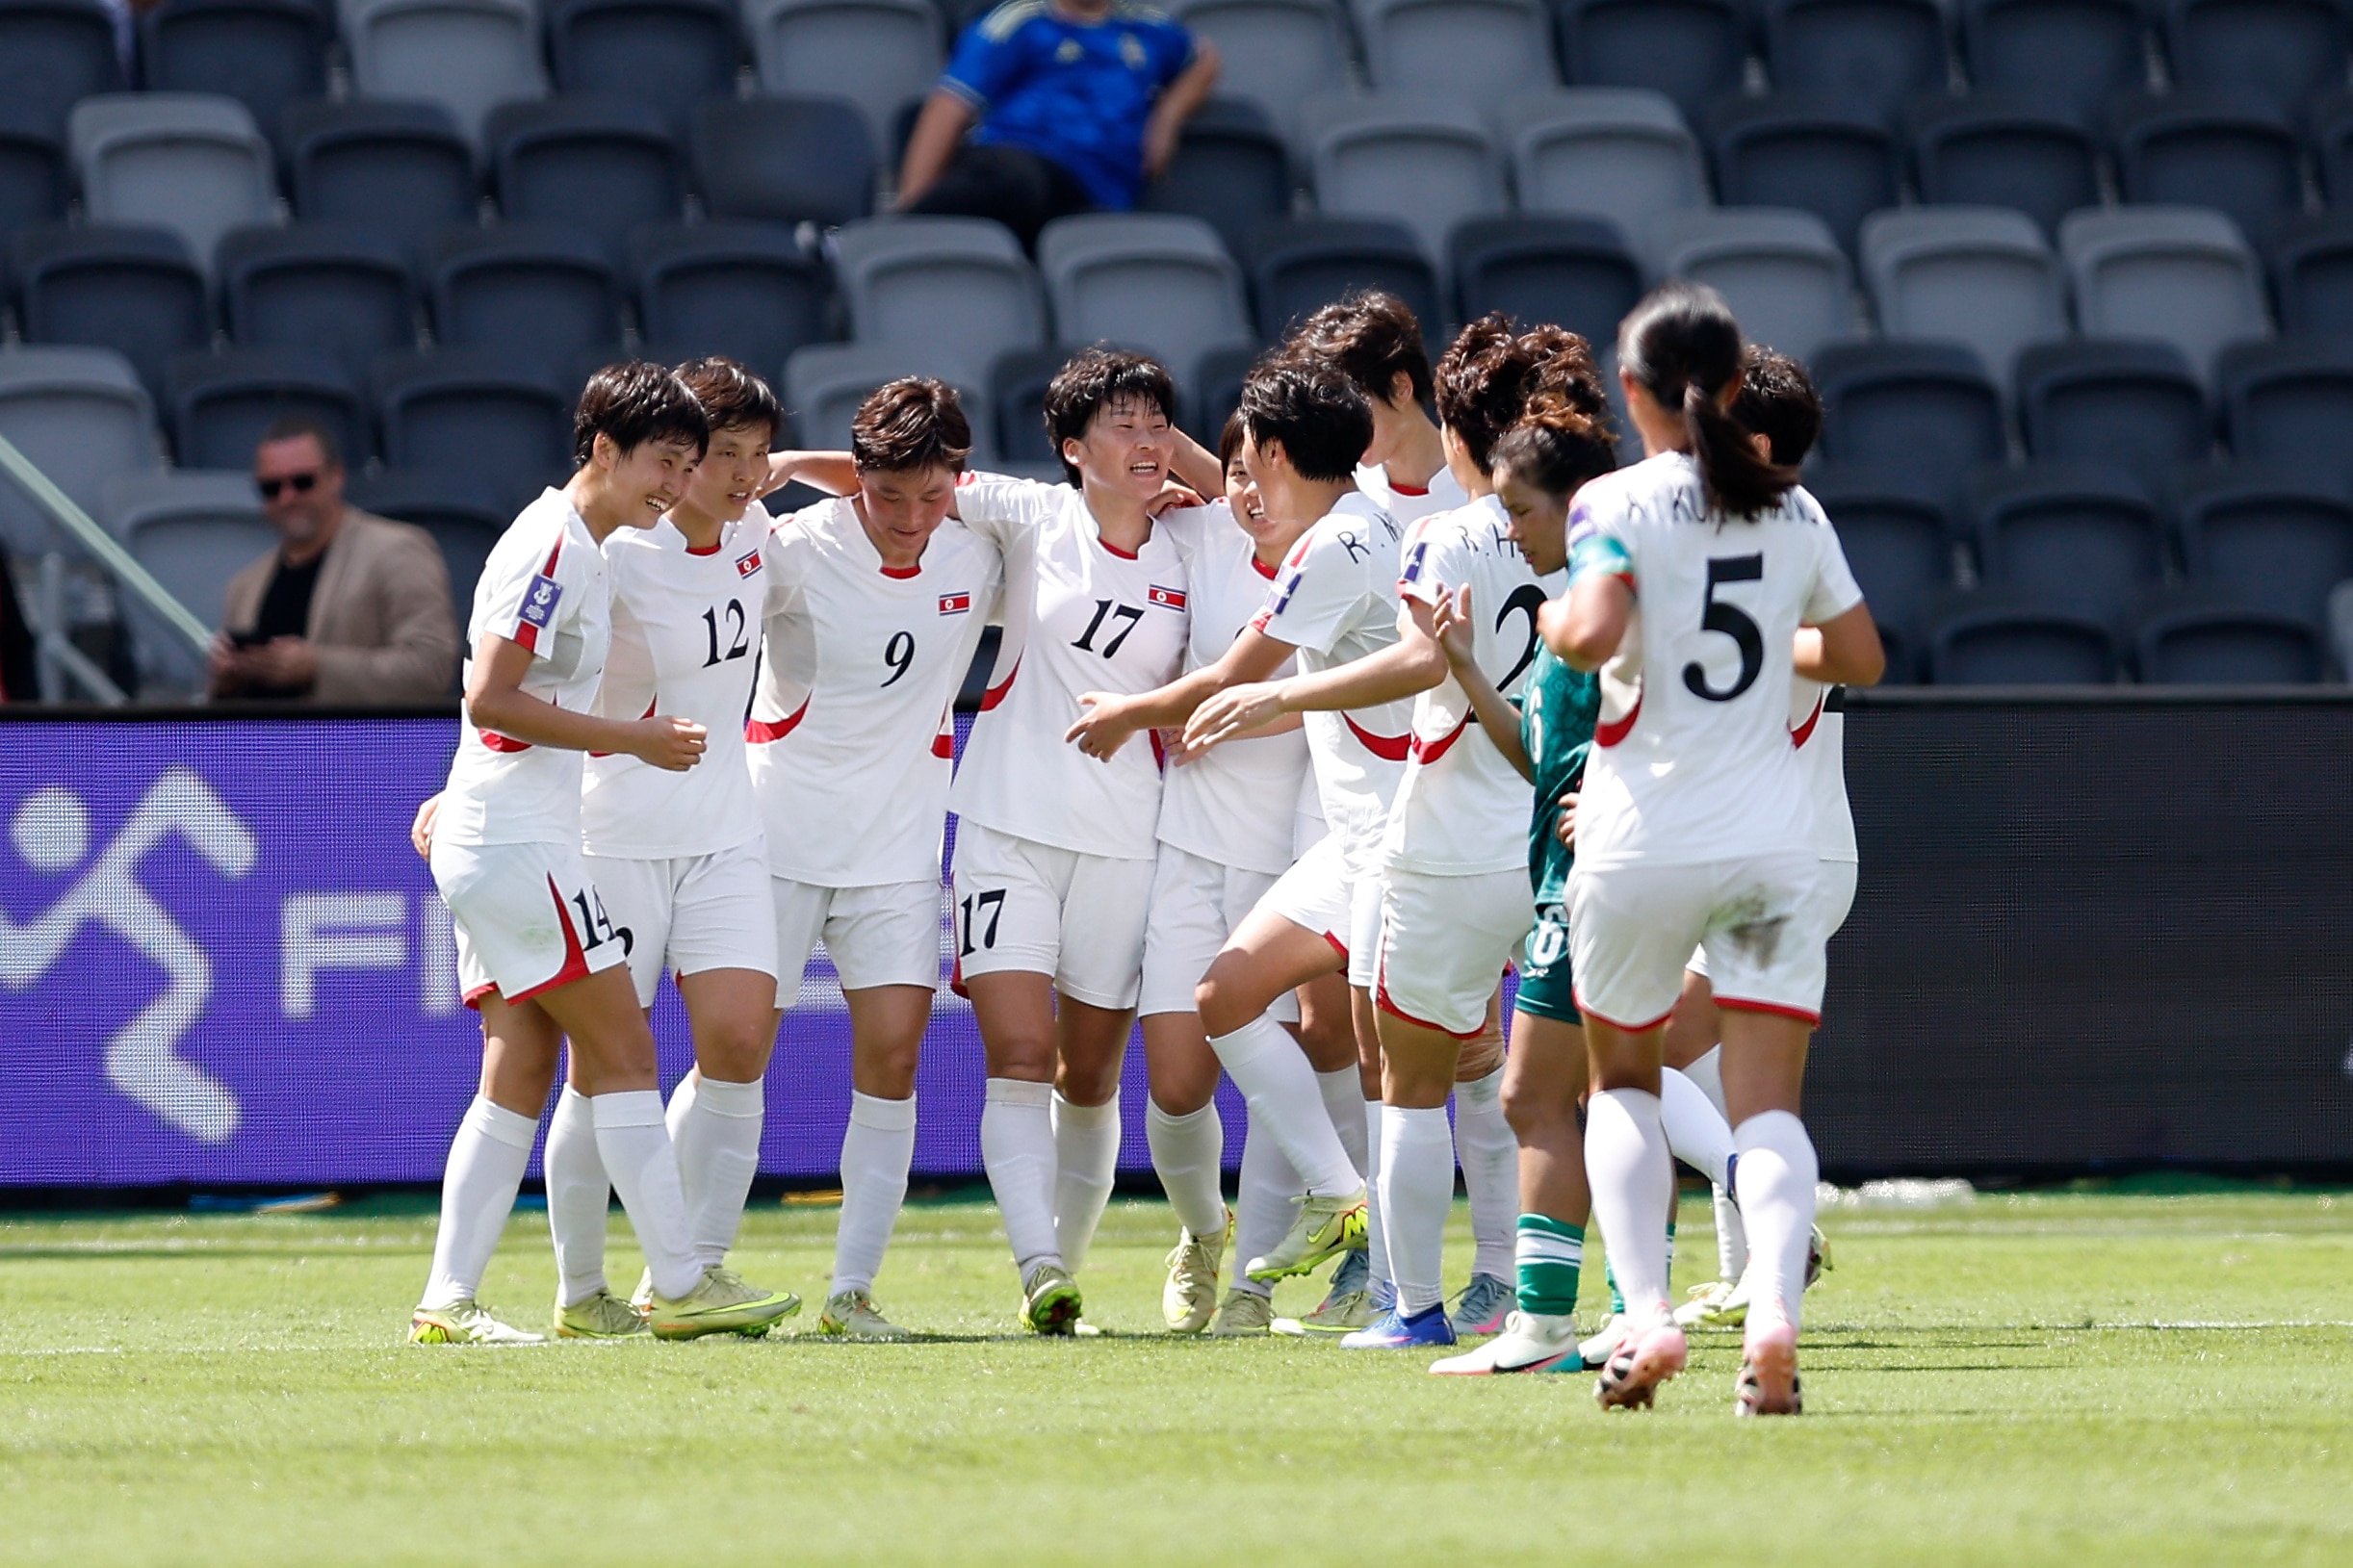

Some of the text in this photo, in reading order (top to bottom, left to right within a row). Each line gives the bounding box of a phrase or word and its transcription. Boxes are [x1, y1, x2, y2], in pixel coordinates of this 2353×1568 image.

[701, 598, 750, 669] 12
[879, 630, 917, 689] 9
[1070, 598, 1146, 660] 17
[1681, 552, 1765, 703] 5
[572, 884, 617, 952] 14
[960, 887, 1007, 959] 17
[1532, 904, 1569, 967] 6
